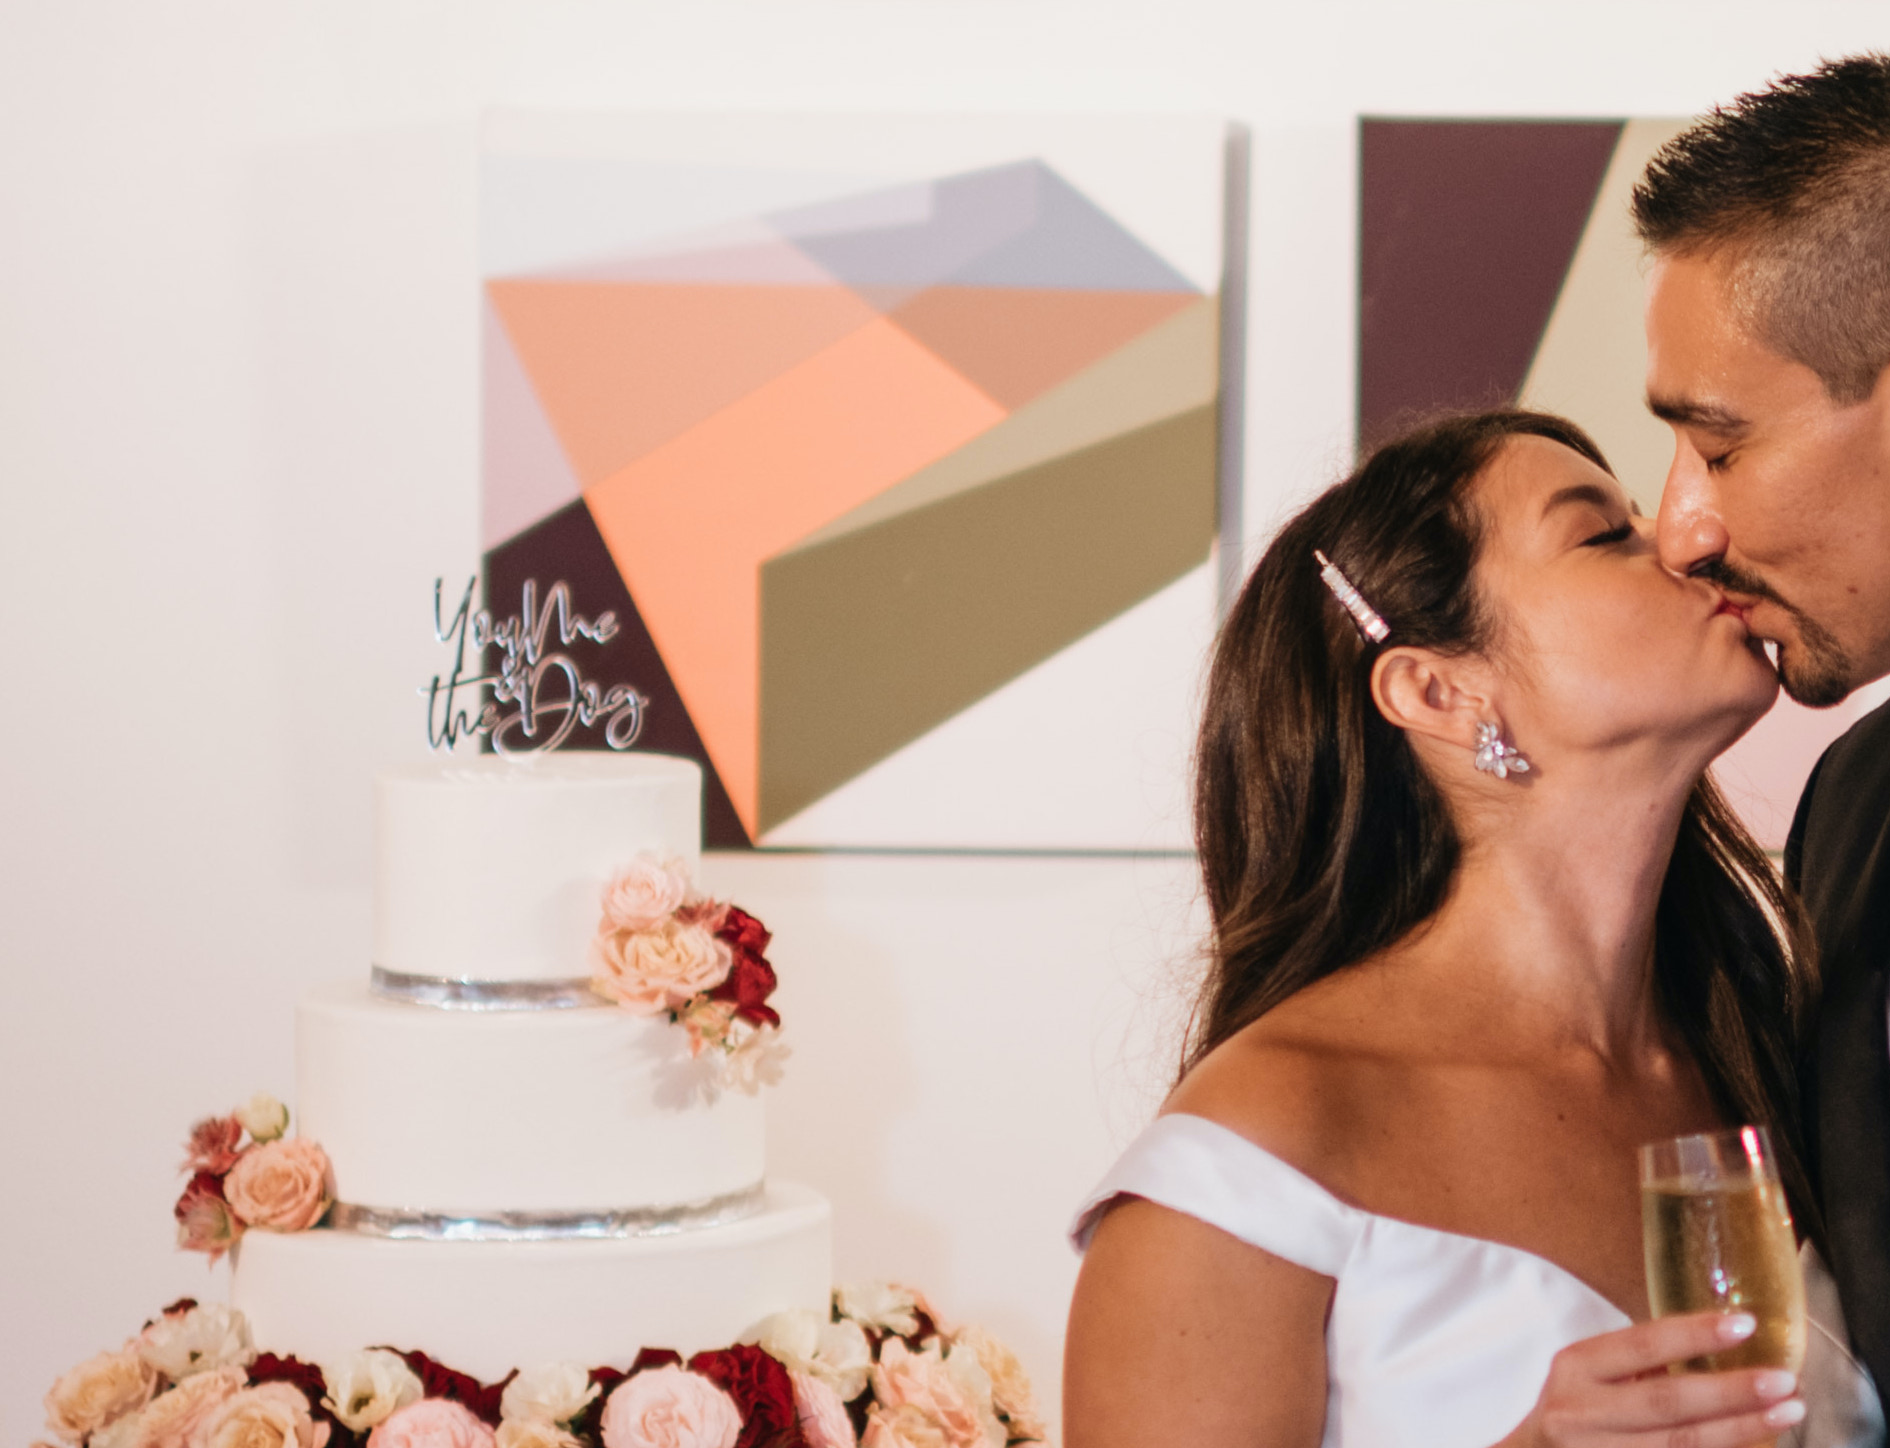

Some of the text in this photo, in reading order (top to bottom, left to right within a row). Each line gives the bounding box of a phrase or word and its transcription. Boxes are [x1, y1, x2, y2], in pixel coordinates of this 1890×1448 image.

[519, 577, 620, 664] Me
[417, 653, 649, 763] the Dog
